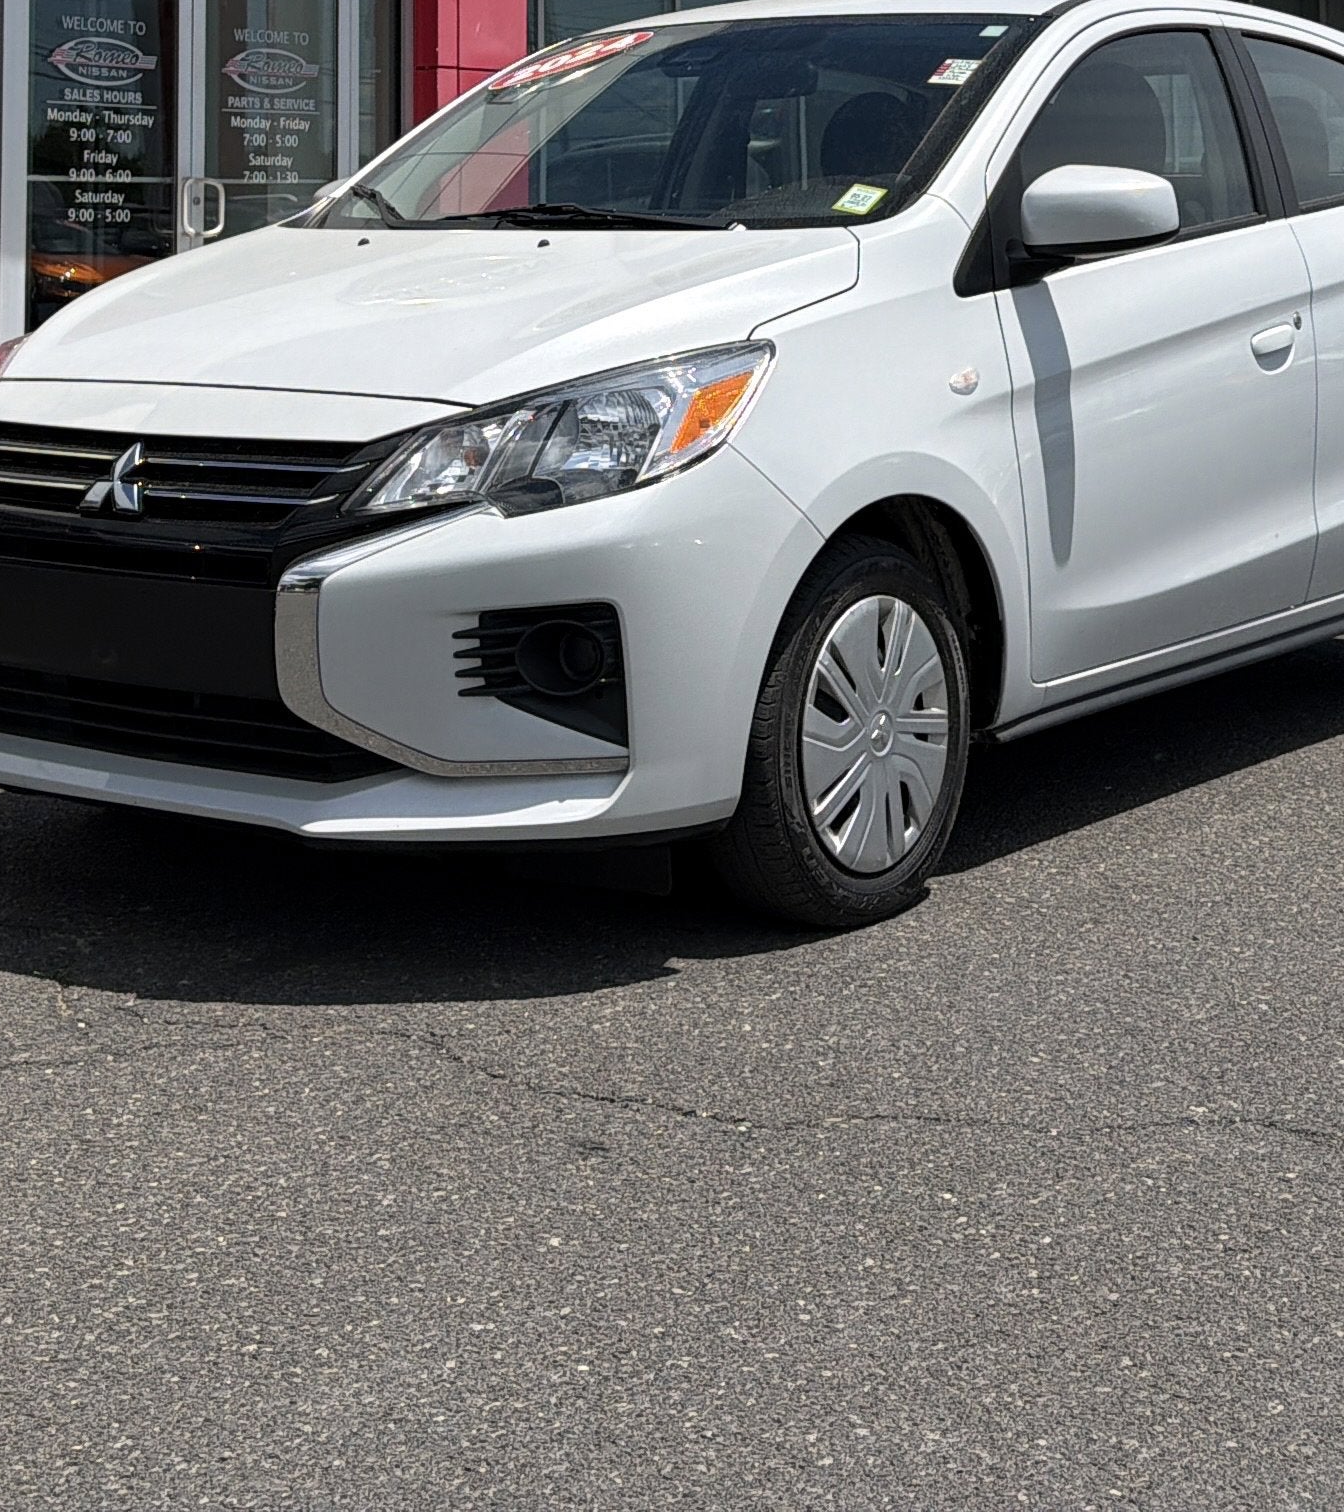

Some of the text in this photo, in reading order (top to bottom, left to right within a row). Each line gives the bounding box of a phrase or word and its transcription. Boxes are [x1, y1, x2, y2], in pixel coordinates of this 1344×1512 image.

[62, 15, 146, 36] WELCOME TO
[233, 28, 309, 46] WELCOME TO
[73, 40, 140, 65] Romeo
[503, 34, 637, 86] 2024
[240, 50, 304, 73] Romeo
[78, 66, 128, 79] NISSAN
[249, 74, 293, 86] NISSAN
[64, 88, 143, 105] SALES HOURS
[228, 96, 316, 111] PARTS & SERVICE
[47, 108, 93, 125] Monday
[102, 111, 155, 128] Thursday
[230, 115, 272, 131] Monday
[279, 117, 311, 133] Friday
[69, 128, 96, 141] 9:00
[106, 129, 132, 143] 7:00
[242, 134, 267, 147] 7:00
[275, 135, 299, 148] 5:00
[83, 150, 119, 166] Friday
[248, 153, 293, 169] Saturday
[69, 168, 96, 182] 9:00
[105, 169, 132, 183] 6:00
[242, 171, 267, 183] 7:00
[74, 189, 125, 206] Saturday
[67, 208, 95, 222] 9:00
[105, 209, 131, 223] 5:00
